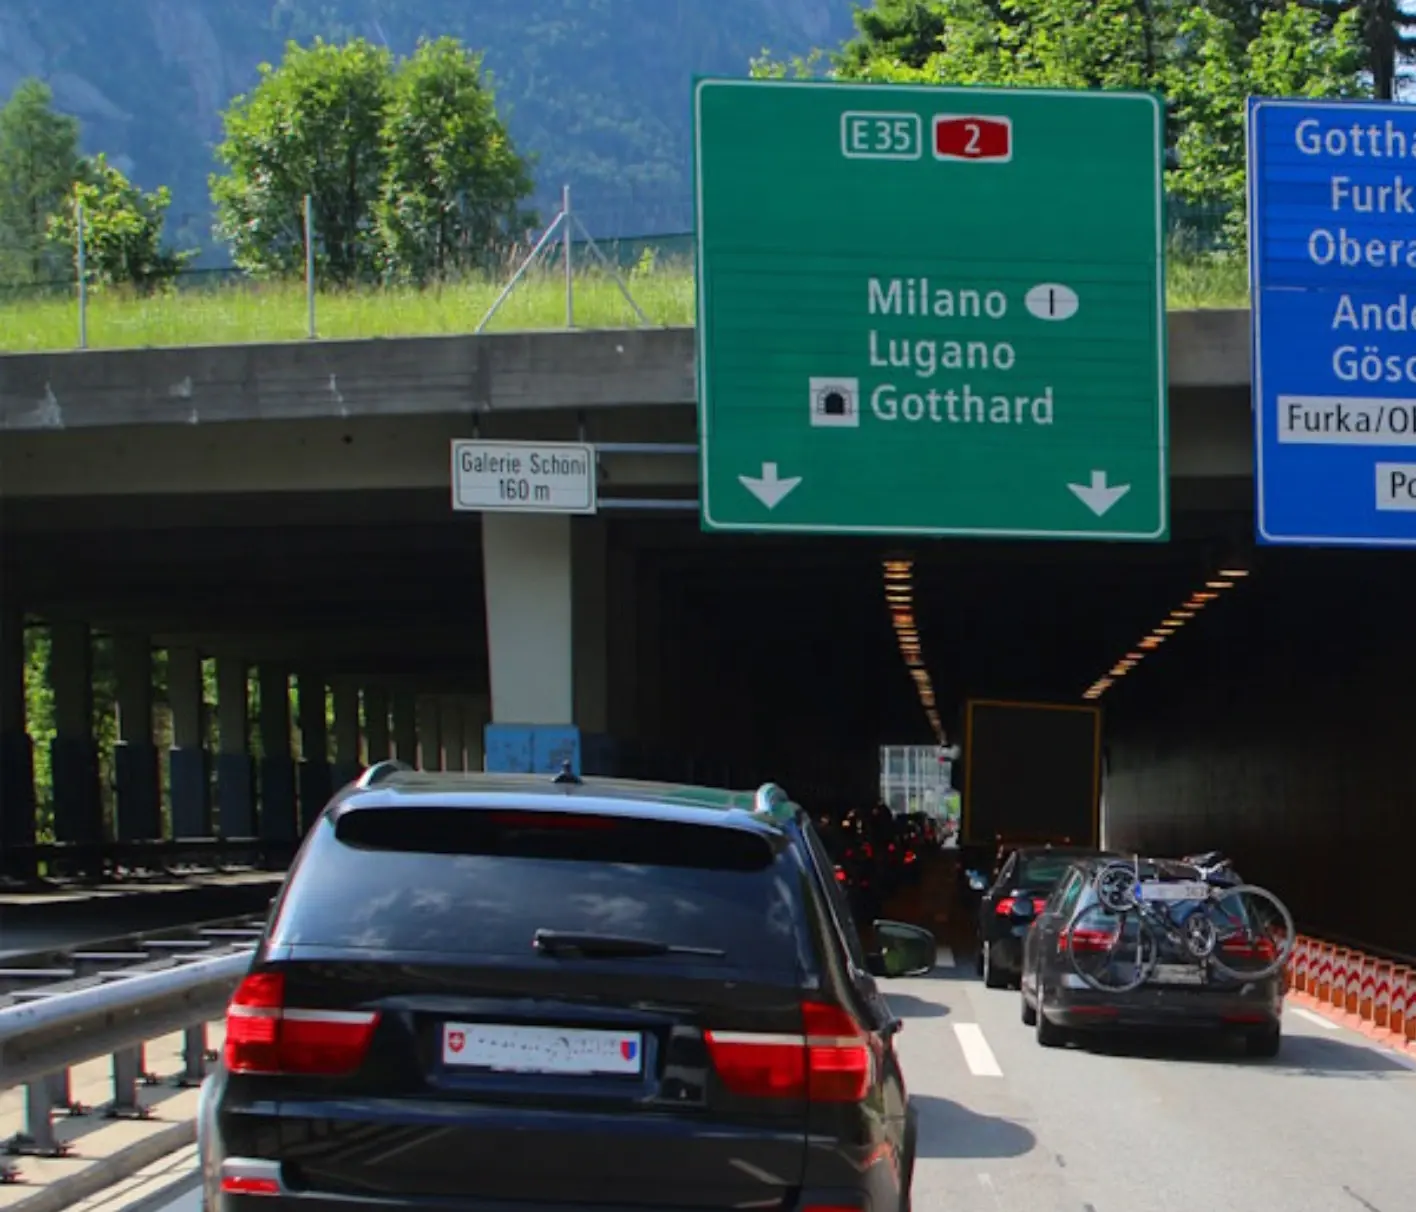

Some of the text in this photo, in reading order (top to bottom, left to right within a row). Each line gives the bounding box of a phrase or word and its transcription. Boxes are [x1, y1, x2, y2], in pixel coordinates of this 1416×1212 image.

[964, 124, 981, 153] 2
[868, 277, 1007, 318] Milano
[869, 330, 1015, 377] Lugano
[870, 384, 1053, 425] Gotthard
[461, 452, 521, 473] Galerie
[499, 478, 551, 500] 160 m
